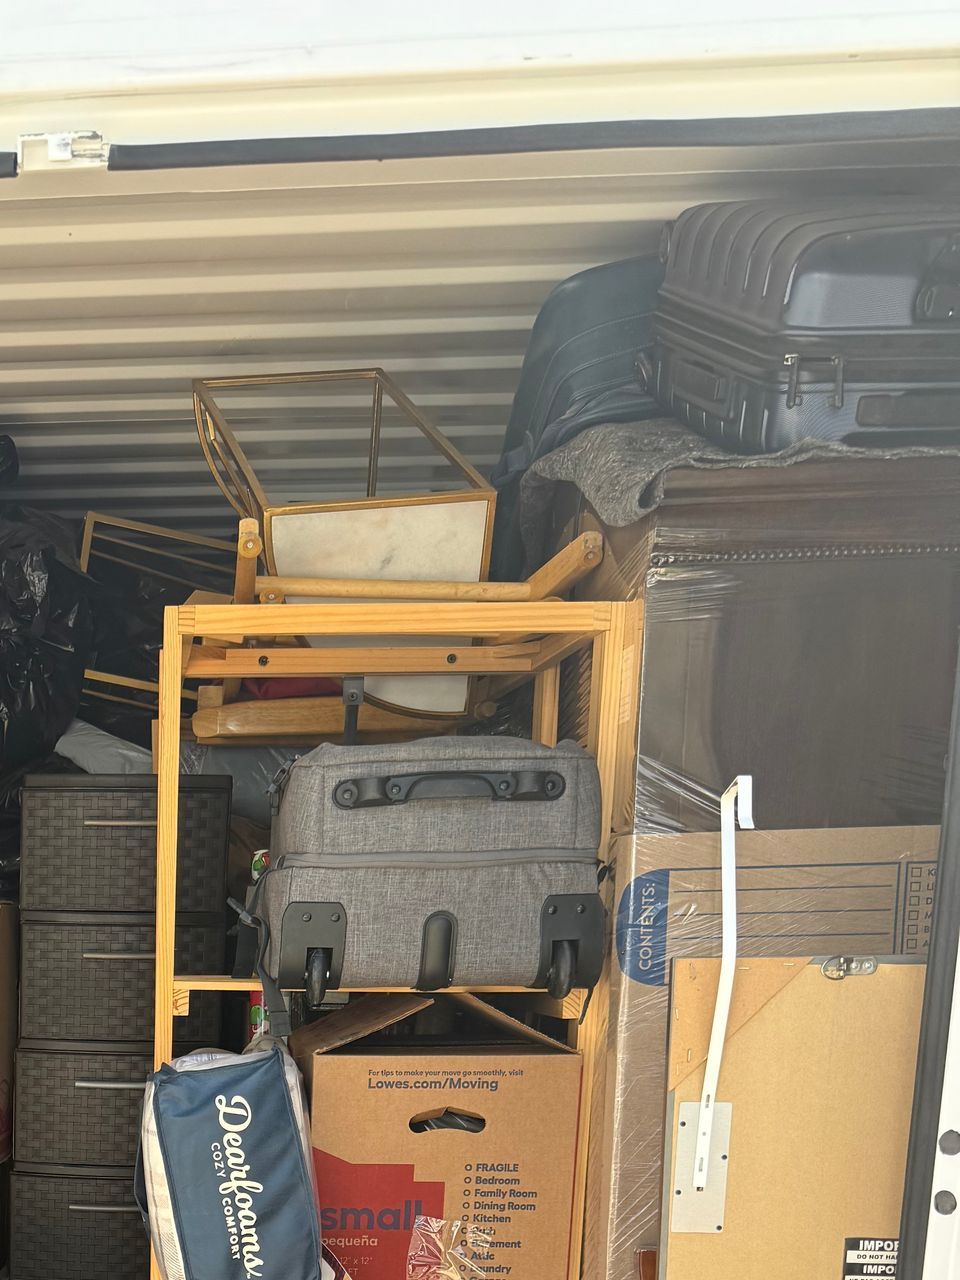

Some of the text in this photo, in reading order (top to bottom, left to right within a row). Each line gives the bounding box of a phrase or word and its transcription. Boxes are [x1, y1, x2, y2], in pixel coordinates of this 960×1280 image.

[639, 882, 655, 971] CONTENTS:
[368, 1078, 498, 1091] Lowes.com/Moving
[212, 1142, 226, 1178] COZY
[476, 1164, 519, 1172] FRAGILE
[475, 1176, 520, 1185] Bedroom
[215, 1095, 264, 1278] Dearfoams
[474, 1189, 537, 1199] Family Room
[474, 1202, 536, 1212] Dining Room
[473, 1214, 511, 1223] Kitchen
[222, 1198, 240, 1260] COMFORT
